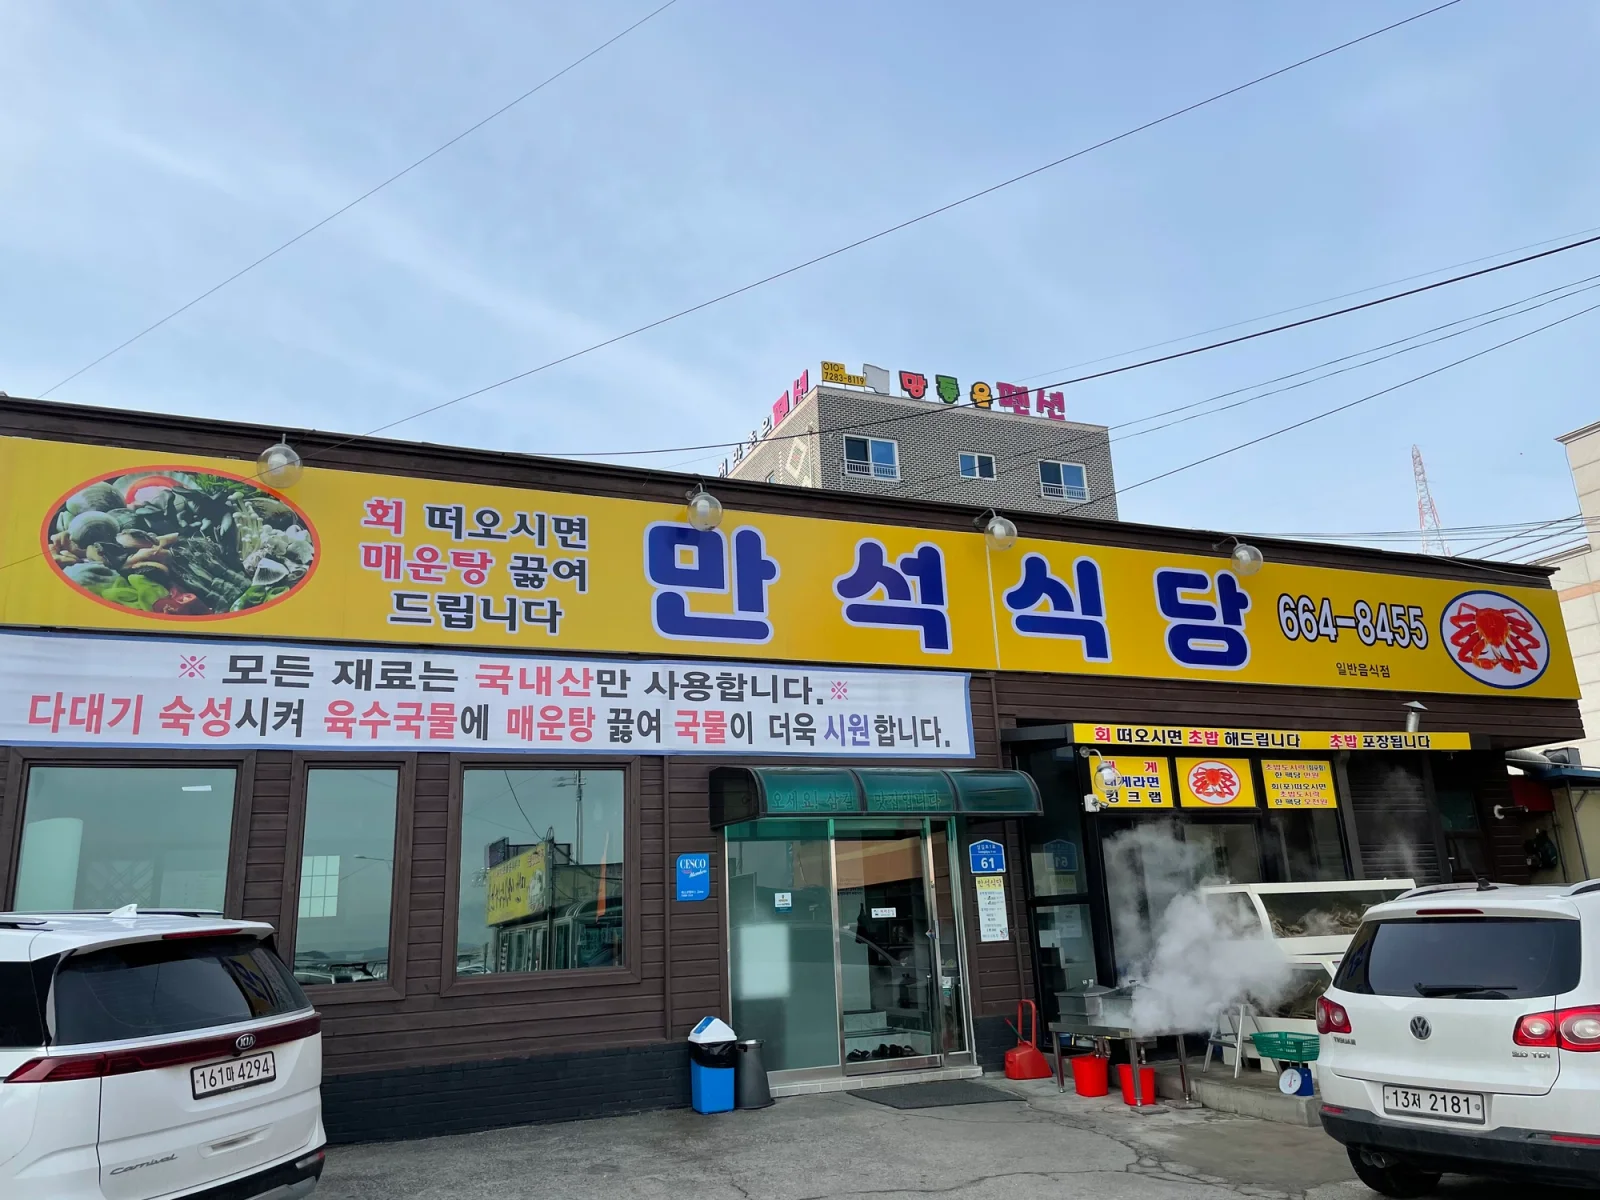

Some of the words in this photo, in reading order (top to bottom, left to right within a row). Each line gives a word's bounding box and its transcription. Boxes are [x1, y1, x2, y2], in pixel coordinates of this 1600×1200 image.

[823, 362, 844, 372] 010-
[824, 372, 864, 384] 7283-8119
[363, 499, 404, 535] 회
[425, 507, 588, 548] 떠오시면
[361, 543, 494, 586] 매운탕
[510, 553, 588, 592] 끓여
[389, 591, 562, 635] 드립니다
[1278, 593, 1428, 649] 664-8455
[222, 654, 315, 689] 모든
[333, 658, 458, 693] 재료는
[475, 663, 631, 699] 국내산만
[643, 670, 824, 706] 사용합니다.
[1336, 662, 1391, 678] 일반음식점
[28, 692, 144, 735] 다대기
[158, 696, 304, 737] 숙성시켜
[324, 701, 489, 741] 육수국물에
[507, 704, 596, 744] 매운탕
[607, 709, 661, 744] 끓여
[675, 710, 753, 744] 국물이
[769, 712, 816, 746] 더욱
[824, 714, 951, 748] 시원합니다.
[1094, 727, 1111, 743] 회
[1117, 727, 1182, 745] 떠오시면
[1189, 729, 1219, 746] 초밥
[1225, 731, 1300, 748] 해드립니다
[1330, 732, 1357, 748] 초밥
[1362, 732, 1430, 749] 포장됩니다
[680, 858, 706, 869] CESCO
[980, 857, 995, 869] 61
[239, 1035, 254, 1048] KIA
[238, 1057, 270, 1081] 4294
[1392, 1089, 1421, 1109] 13저
[1429, 1094, 1471, 1115] 2181
